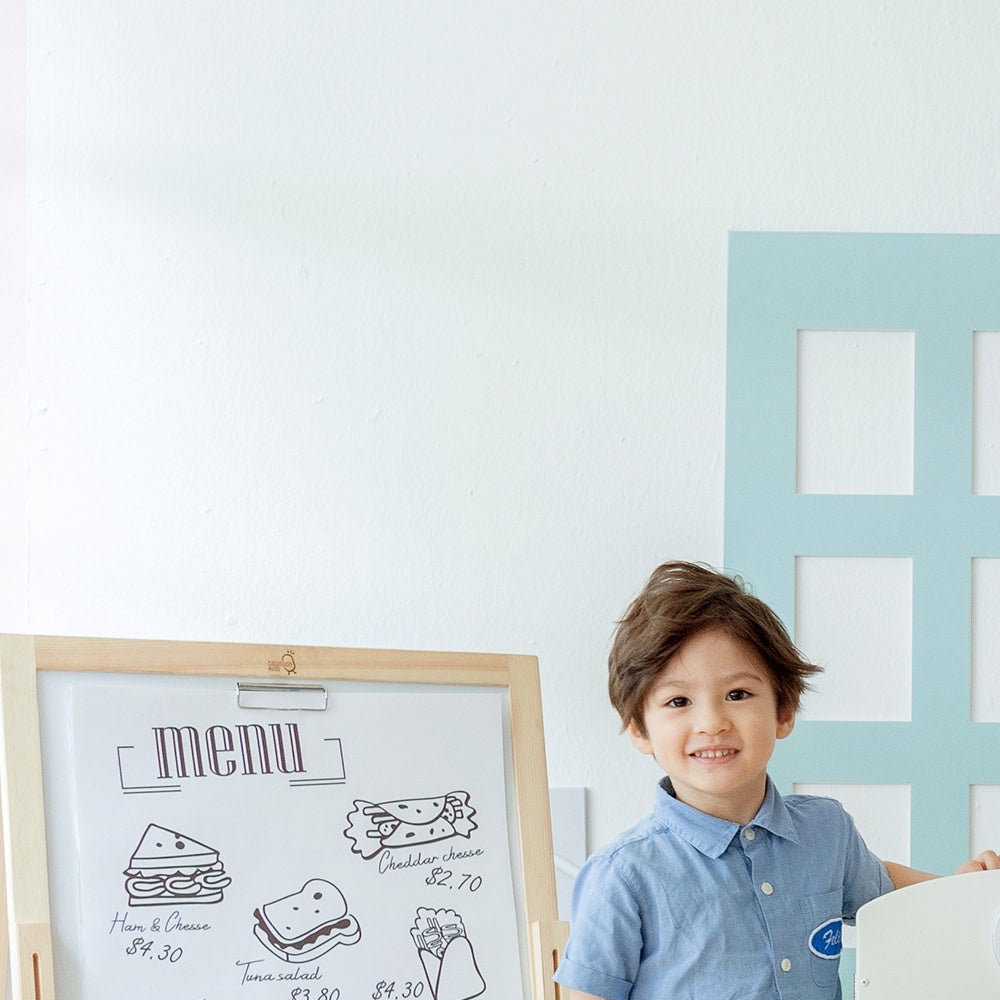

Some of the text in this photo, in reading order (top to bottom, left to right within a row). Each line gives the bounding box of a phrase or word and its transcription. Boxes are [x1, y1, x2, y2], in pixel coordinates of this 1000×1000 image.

[152, 723, 307, 779] menu
[378, 846, 485, 875] Cheddar chesse
[425, 866, 483, 892] $2.70
[109, 910, 212, 934] Ham & Chesse
[126, 937, 184, 963] $4.30
[236, 959, 323, 985] Tuna salad
[371, 980, 424, 1000] $4.30
